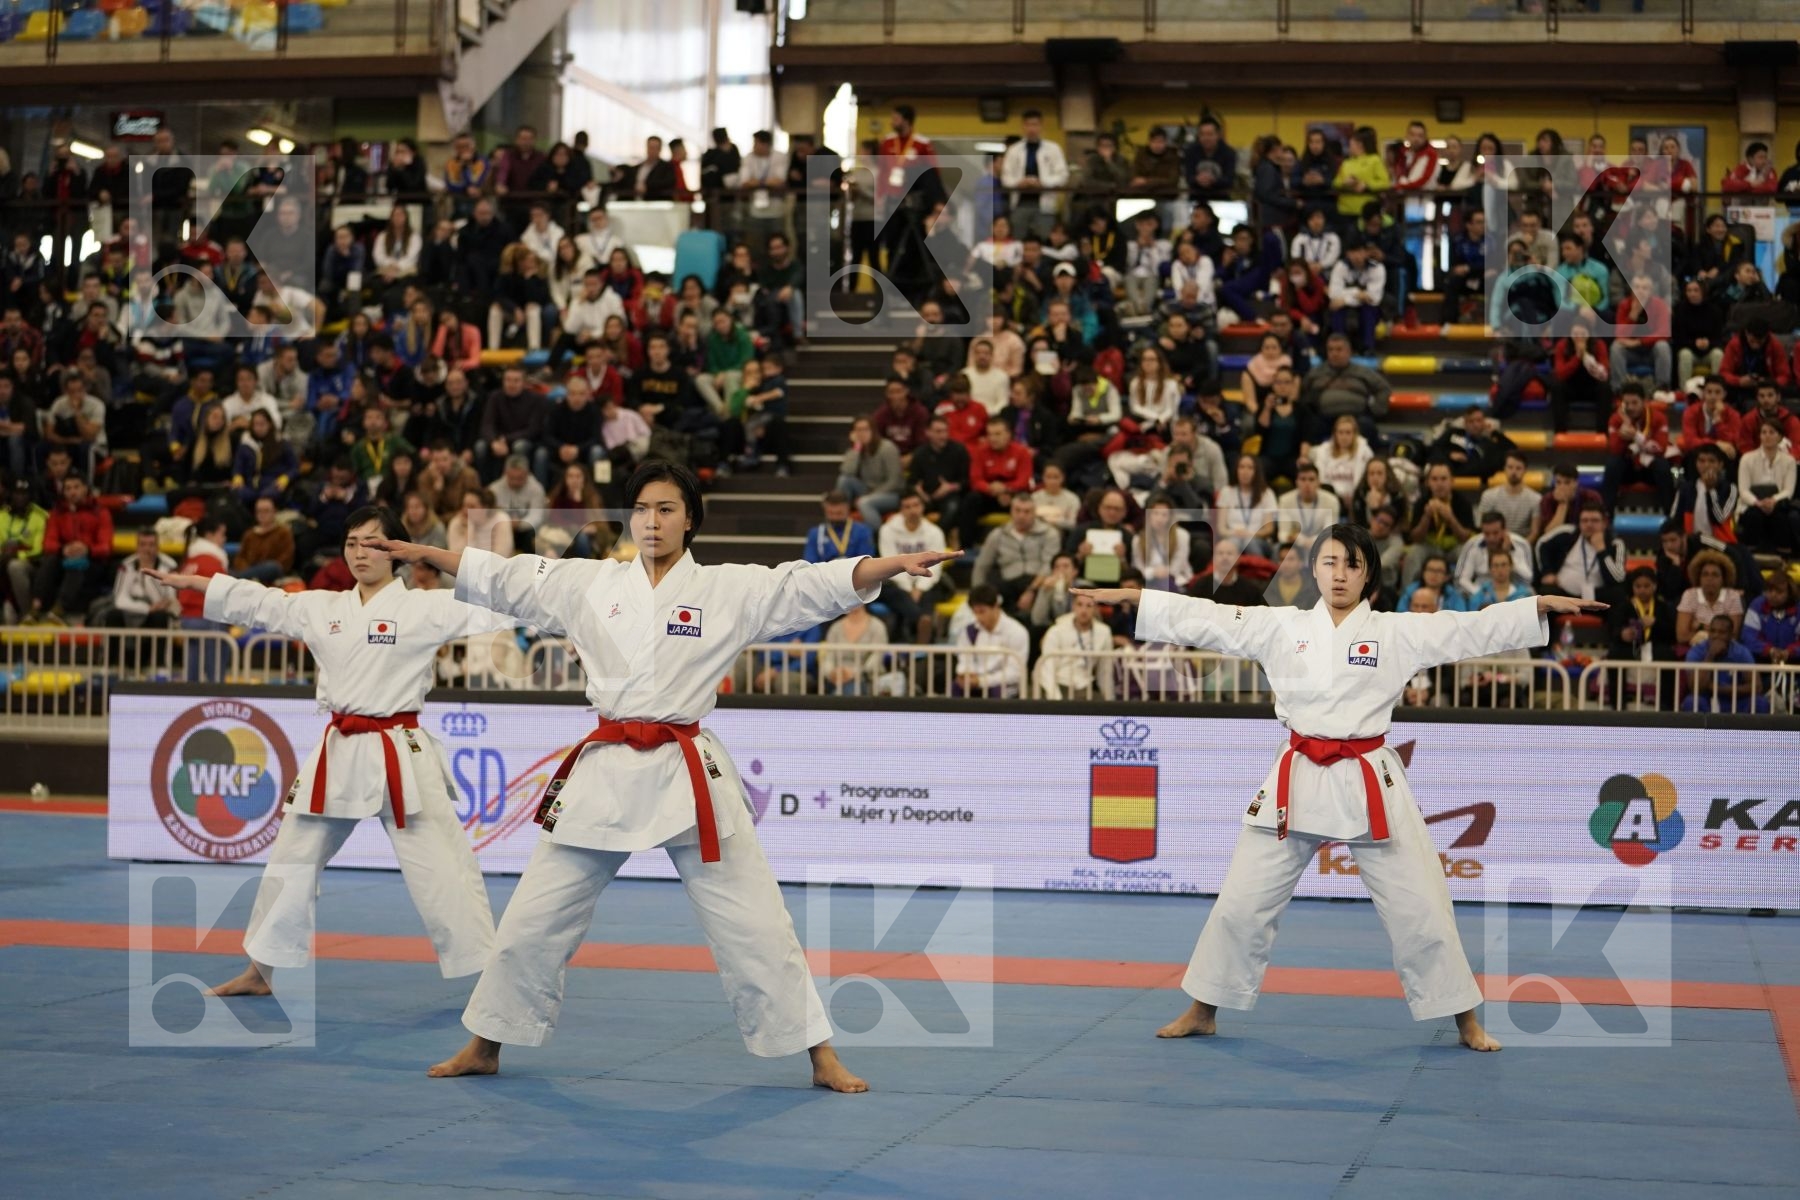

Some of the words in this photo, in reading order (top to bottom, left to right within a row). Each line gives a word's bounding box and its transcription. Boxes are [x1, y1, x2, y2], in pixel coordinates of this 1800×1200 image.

[369, 635, 395, 644] JAPAN
[668, 625, 700, 637] JAPAN
[1349, 657, 1377, 667] JAPAN
[202, 702, 253, 719] WORLD
[1089, 748, 1159, 761] KARATE
[188, 763, 259, 797] WKF
[453, 747, 506, 823] SD
[840, 783, 930, 802] Programas
[780, 793, 800, 816] D
[840, 804, 885, 824] Mujer
[889, 809, 899, 824] y
[902, 805, 974, 825] Deporte
[1699, 834, 1798, 852] SER
[1318, 846, 1484, 879] kte
[1073, 867, 1099, 878] REAL
